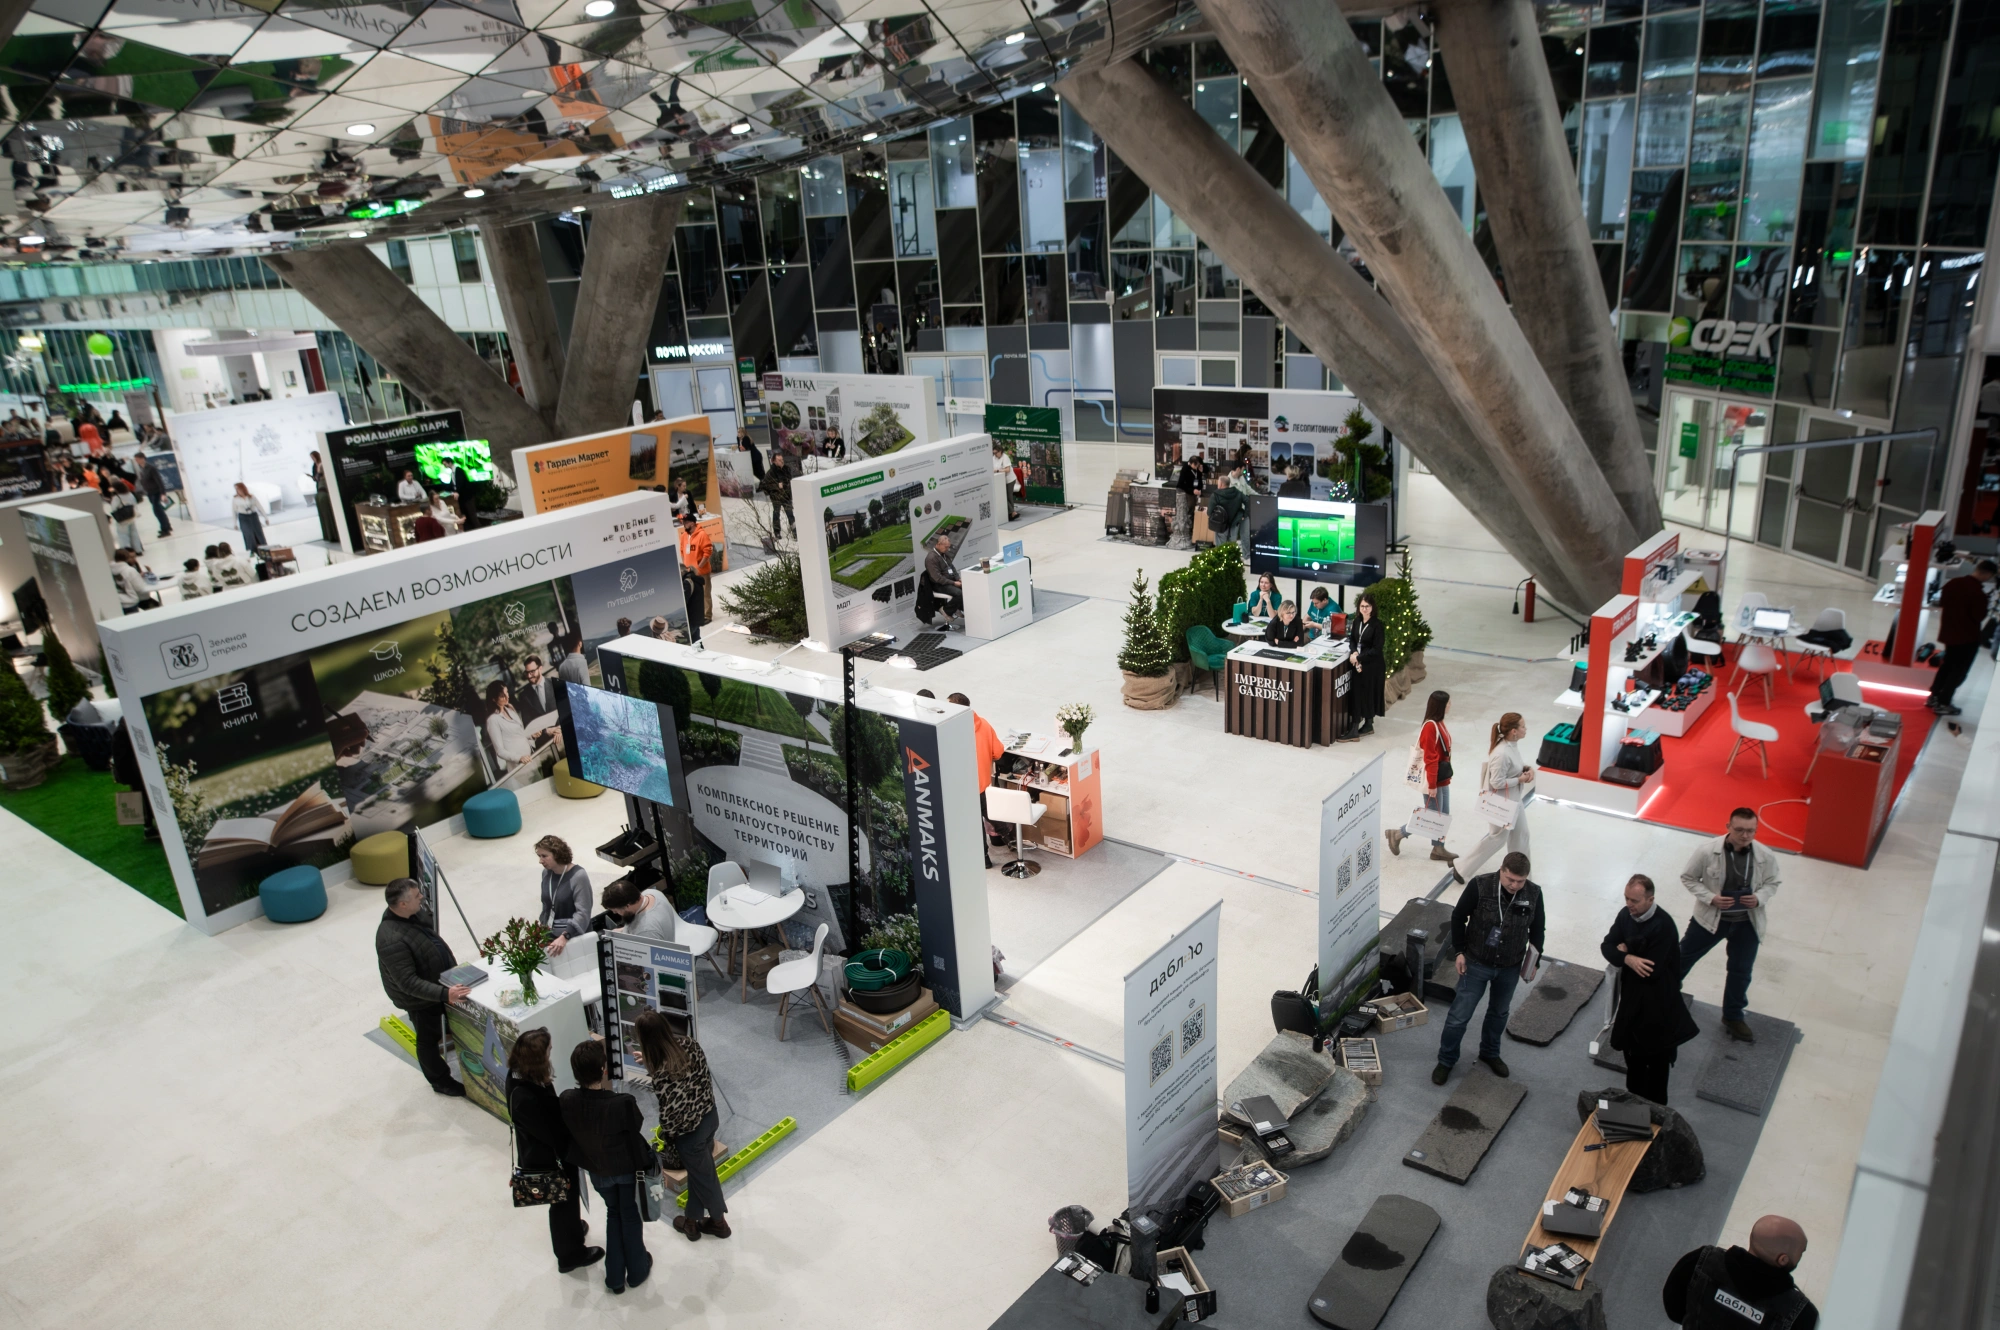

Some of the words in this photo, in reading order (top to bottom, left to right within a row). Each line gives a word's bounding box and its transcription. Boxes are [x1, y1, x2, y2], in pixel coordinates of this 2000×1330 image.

[656, 345, 686, 358] ПОЧТА
[688, 343, 724, 356] РОССИИ
[345, 426, 418, 446] РОМАШКИНО
[420, 420, 449, 432] ПАРК
[1292, 424, 1338, 434] ЛЕСОПИТОМНИК
[1340, 426, 1348, 434] 24
[546, 456, 577, 470] Гарден
[578, 450, 610, 464] Маркет
[823, 488, 830, 496] ТА
[830, 484, 848, 494] САМАЯ
[848, 474, 882, 490] ЭКОПАРКОВКА
[291, 587, 406, 632] СОЗДАЕМ
[411, 542, 572, 600] ВОЗМОЖНОСТИ
[607, 588, 654, 608] ПУТЕШЕСТВИЯ
[836, 600, 850, 610] МДП
[208, 632, 247, 648] Зеленая
[492, 622, 546, 644] МЕРОПРИЯТИЯ
[211, 643, 248, 657] стрела
[373, 666, 406, 682] ШКОЛА
[1234, 673, 1293, 692] IMPERIAL
[1238, 685, 1286, 702] GARDEN
[222, 712, 258, 729] КНИГИ
[697, 784, 780, 818] КОМПЛЕКСНОЕ
[783, 810, 840, 836] РЕШЕНИЕ
[706, 804, 720, 816] ПО
[724, 810, 835, 852] БЛАГОУСТРОЙСТВУ
[914, 767, 940, 882] ANMAKS
[734, 829, 808, 862] ТЕРРИТОРИЙ
[660, 955, 690, 966] ANMAKS
